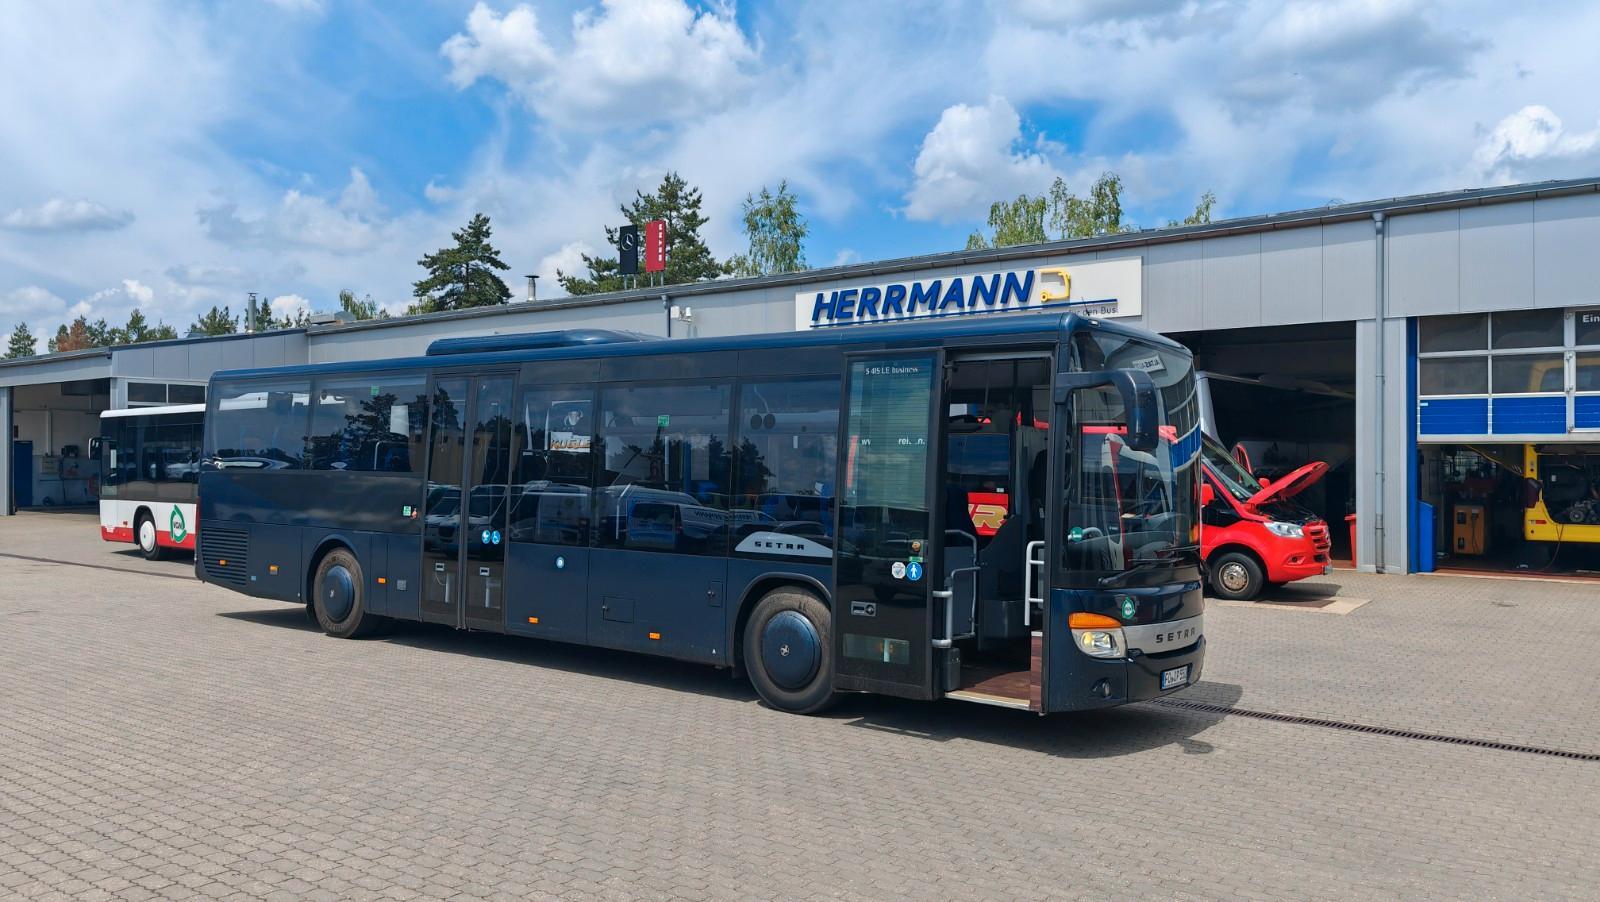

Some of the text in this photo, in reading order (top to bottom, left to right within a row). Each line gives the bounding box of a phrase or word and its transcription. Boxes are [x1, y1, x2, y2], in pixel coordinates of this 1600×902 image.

[811, 270, 1035, 321] HERRMANN
[881, 366, 890, 375] LE
[754, 541, 805, 551] SETRA
[1156, 627, 1195, 643] SETRA
